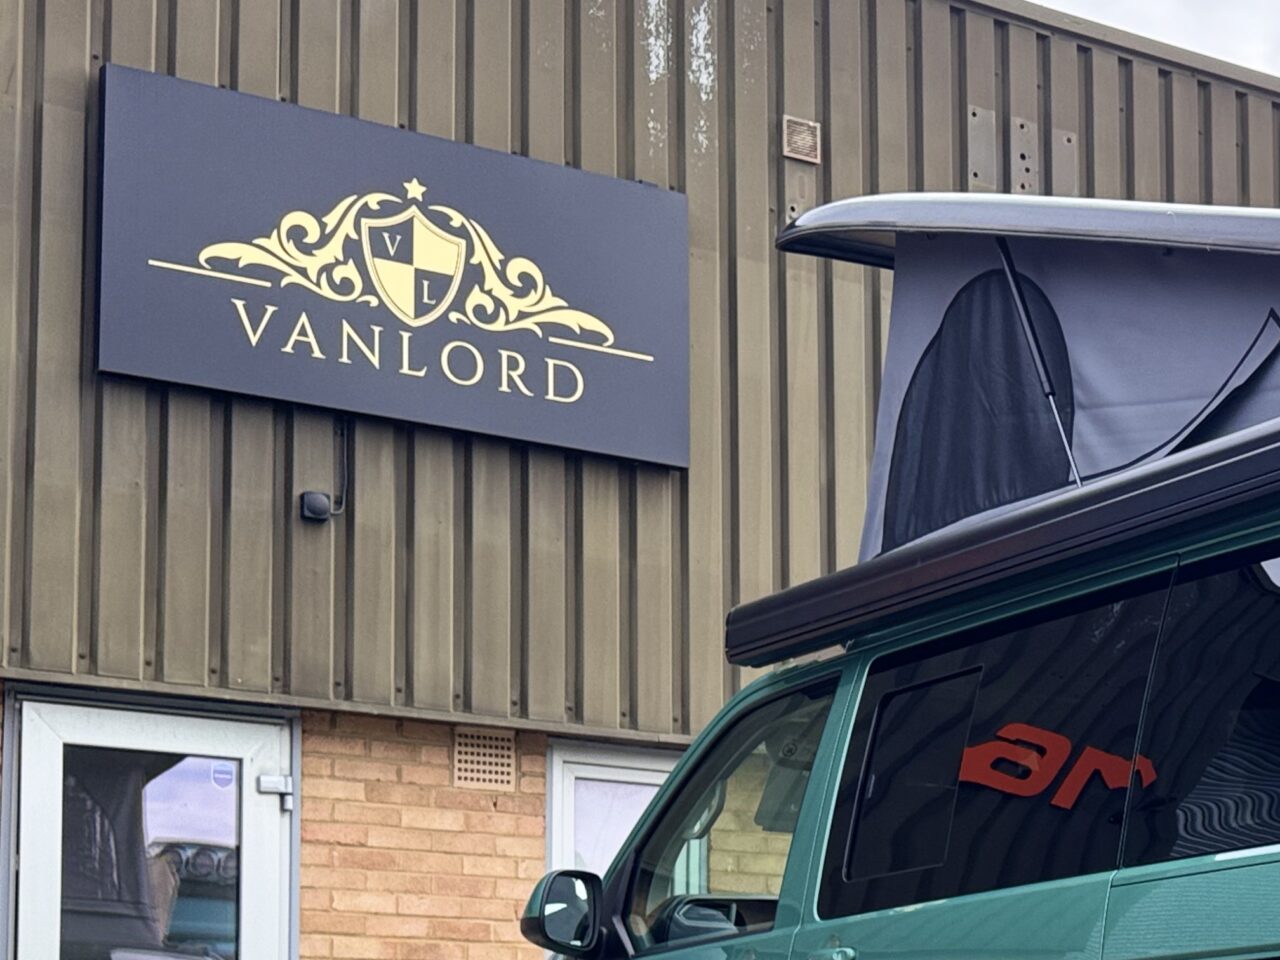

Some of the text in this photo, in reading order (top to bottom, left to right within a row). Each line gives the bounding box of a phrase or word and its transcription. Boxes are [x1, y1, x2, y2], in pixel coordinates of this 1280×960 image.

[382, 231, 402, 257] V
[422, 280, 437, 305] L
[231, 298, 585, 404] VANLORD
